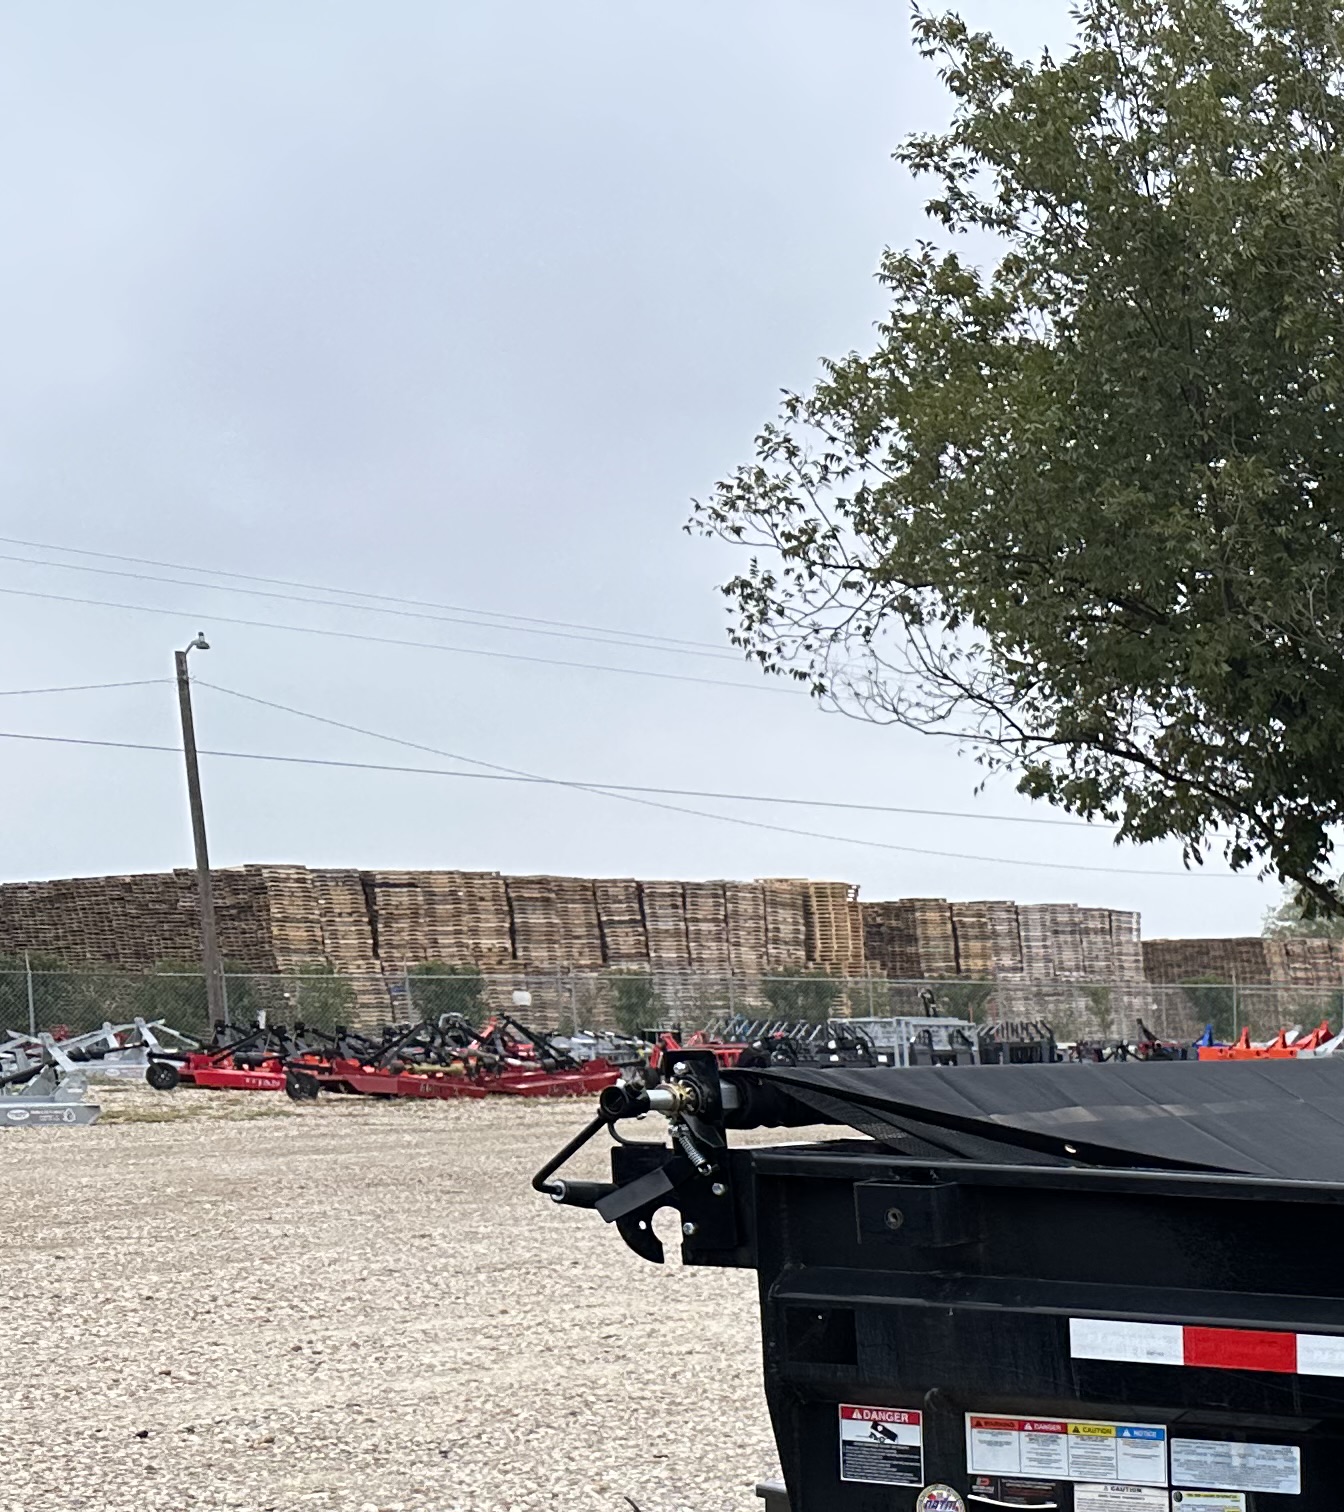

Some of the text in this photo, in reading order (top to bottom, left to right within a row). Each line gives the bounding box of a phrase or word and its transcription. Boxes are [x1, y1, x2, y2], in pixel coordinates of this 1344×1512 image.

[862, 1410, 909, 1423] DANGER
[1033, 1423, 1062, 1432] DANGER
[1082, 1426, 1112, 1435] CAUTION
[1133, 1429, 1157, 1438] NOTICE
